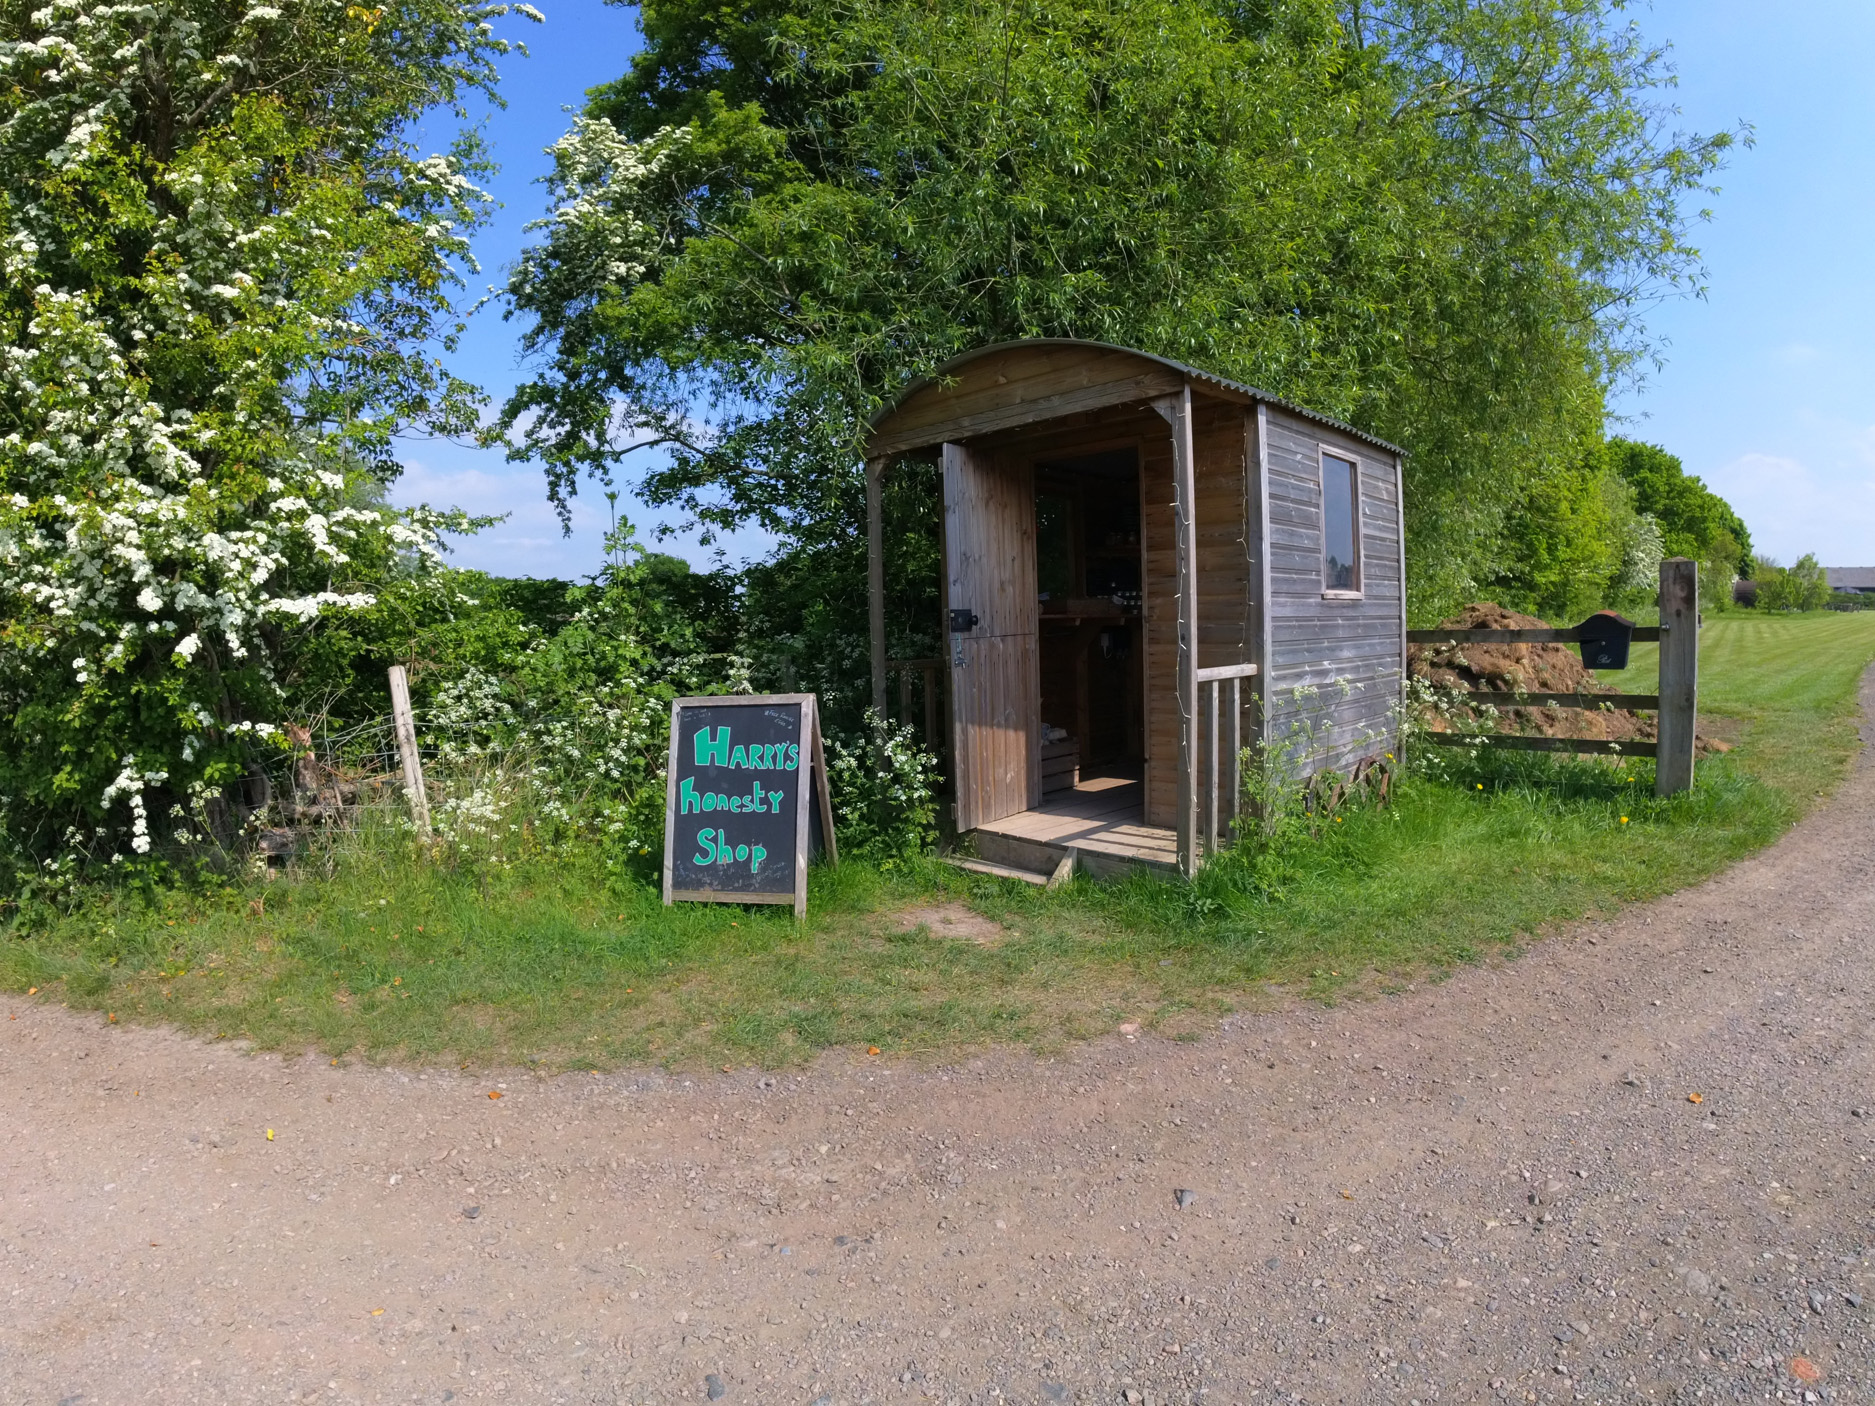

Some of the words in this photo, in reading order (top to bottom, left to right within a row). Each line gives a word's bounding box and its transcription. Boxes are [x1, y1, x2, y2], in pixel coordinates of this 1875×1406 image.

[693, 726, 798, 771] HARRY'S
[680, 776, 784, 815] honesty
[693, 828, 767, 873] Shop
